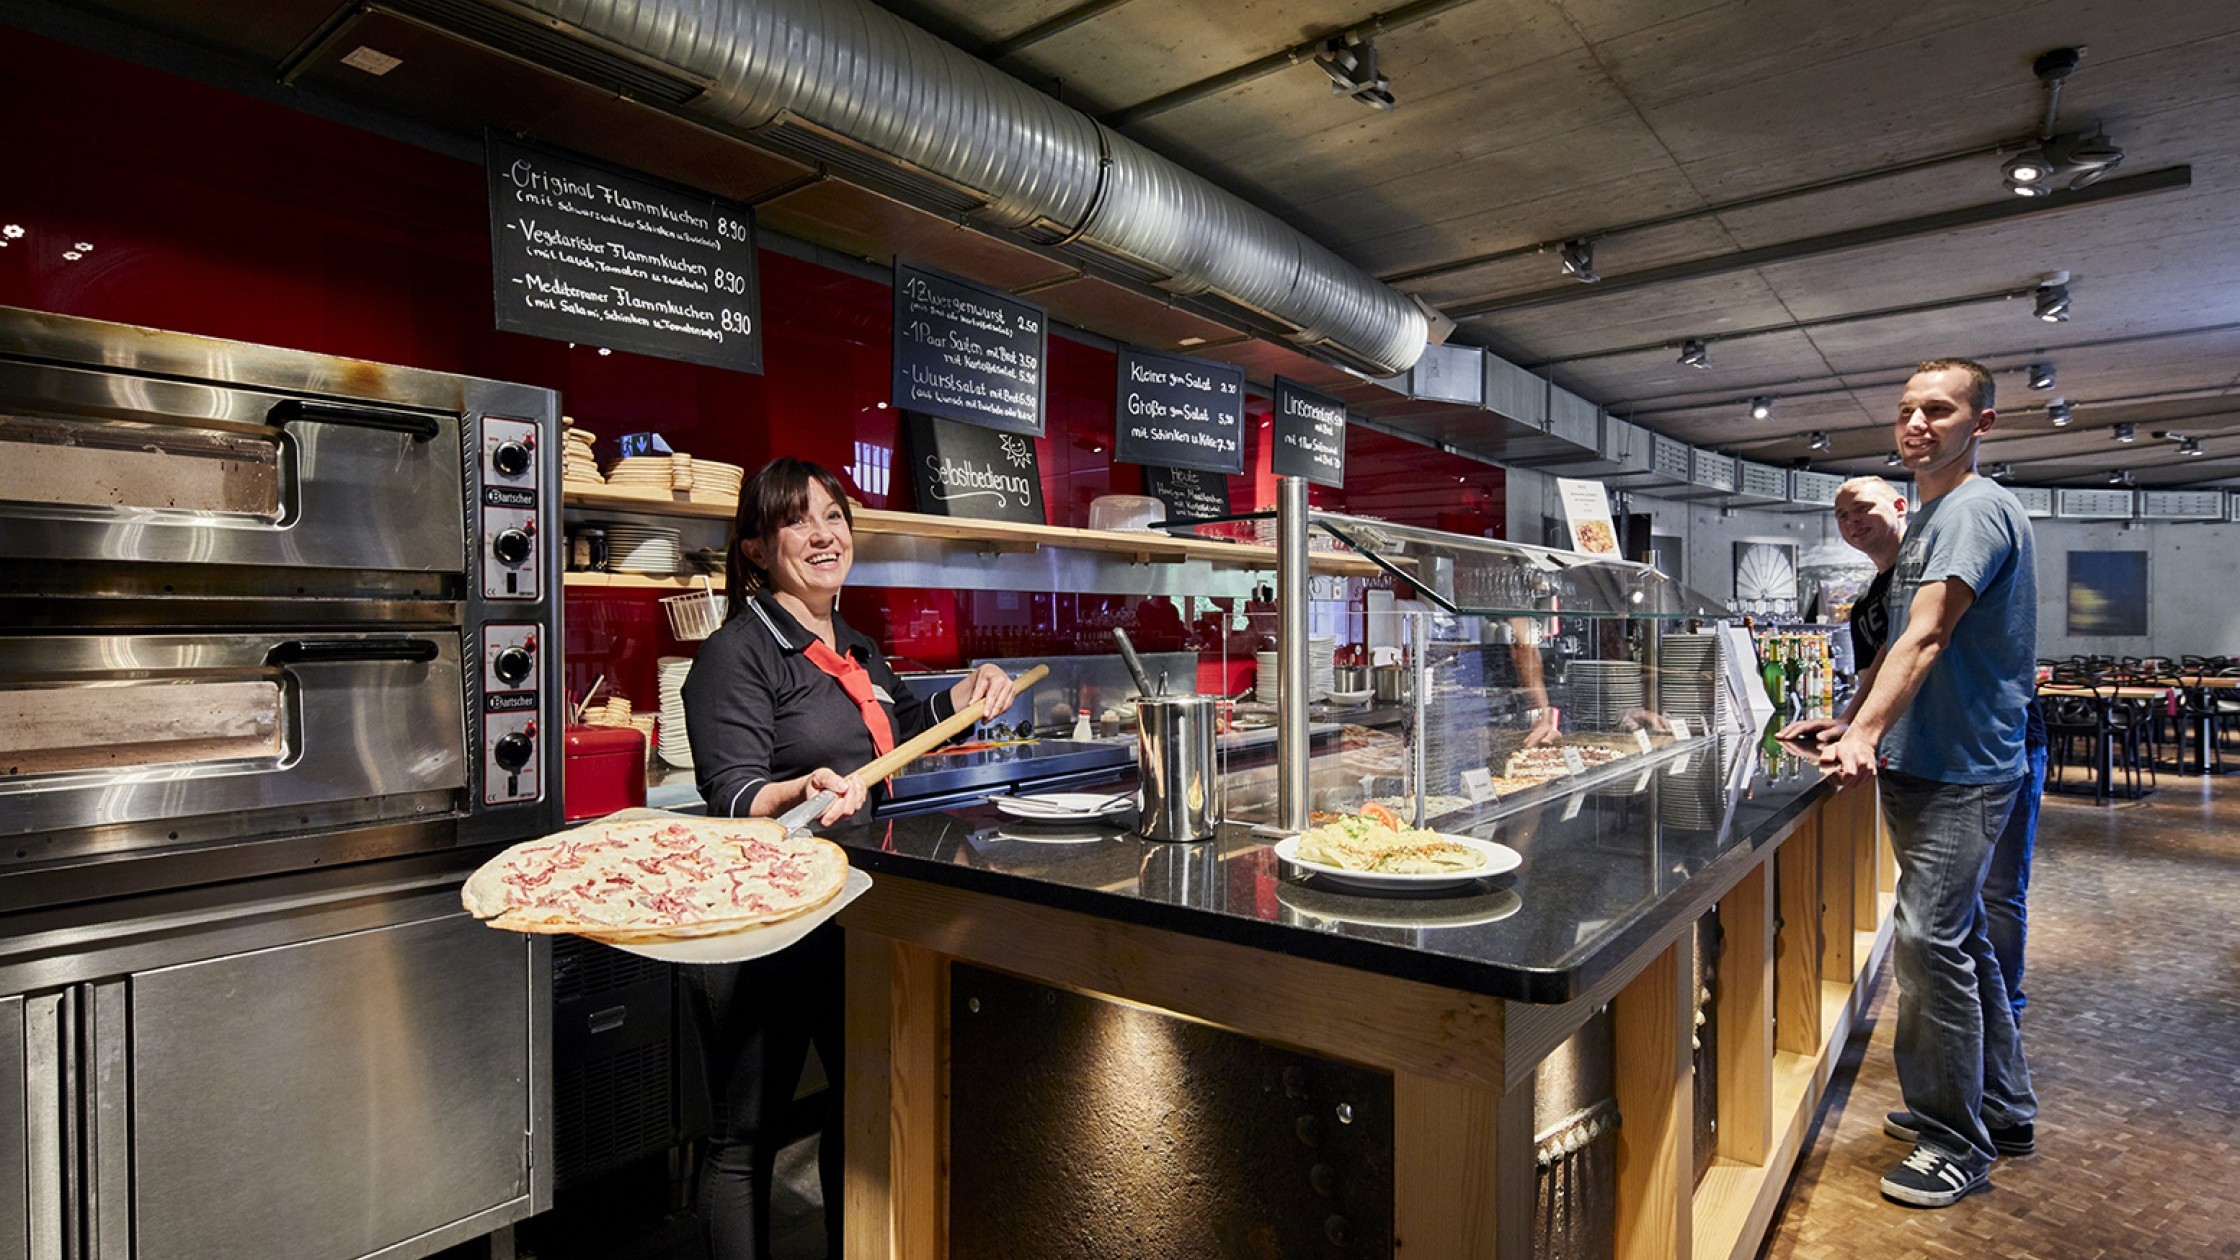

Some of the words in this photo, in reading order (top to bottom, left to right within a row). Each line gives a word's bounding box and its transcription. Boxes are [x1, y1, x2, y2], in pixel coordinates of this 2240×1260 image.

[596, 184, 708, 231] Flammkuchen
[717, 217, 746, 242] 8.90
[606, 242, 707, 277] Flammkuchen
[714, 267, 745, 295] 8.90
[609, 285, 714, 322] Flammkuchen
[721, 308, 751, 335] 8.90
[1130, 360, 1167, 384] Kleiner
[1184, 372, 1212, 391] Salat
[1128, 393, 1167, 418] Großer
[1182, 404, 1210, 422] Salat
[1131, 427, 1149, 439] mit
[1150, 428, 1190, 443] Schinken
